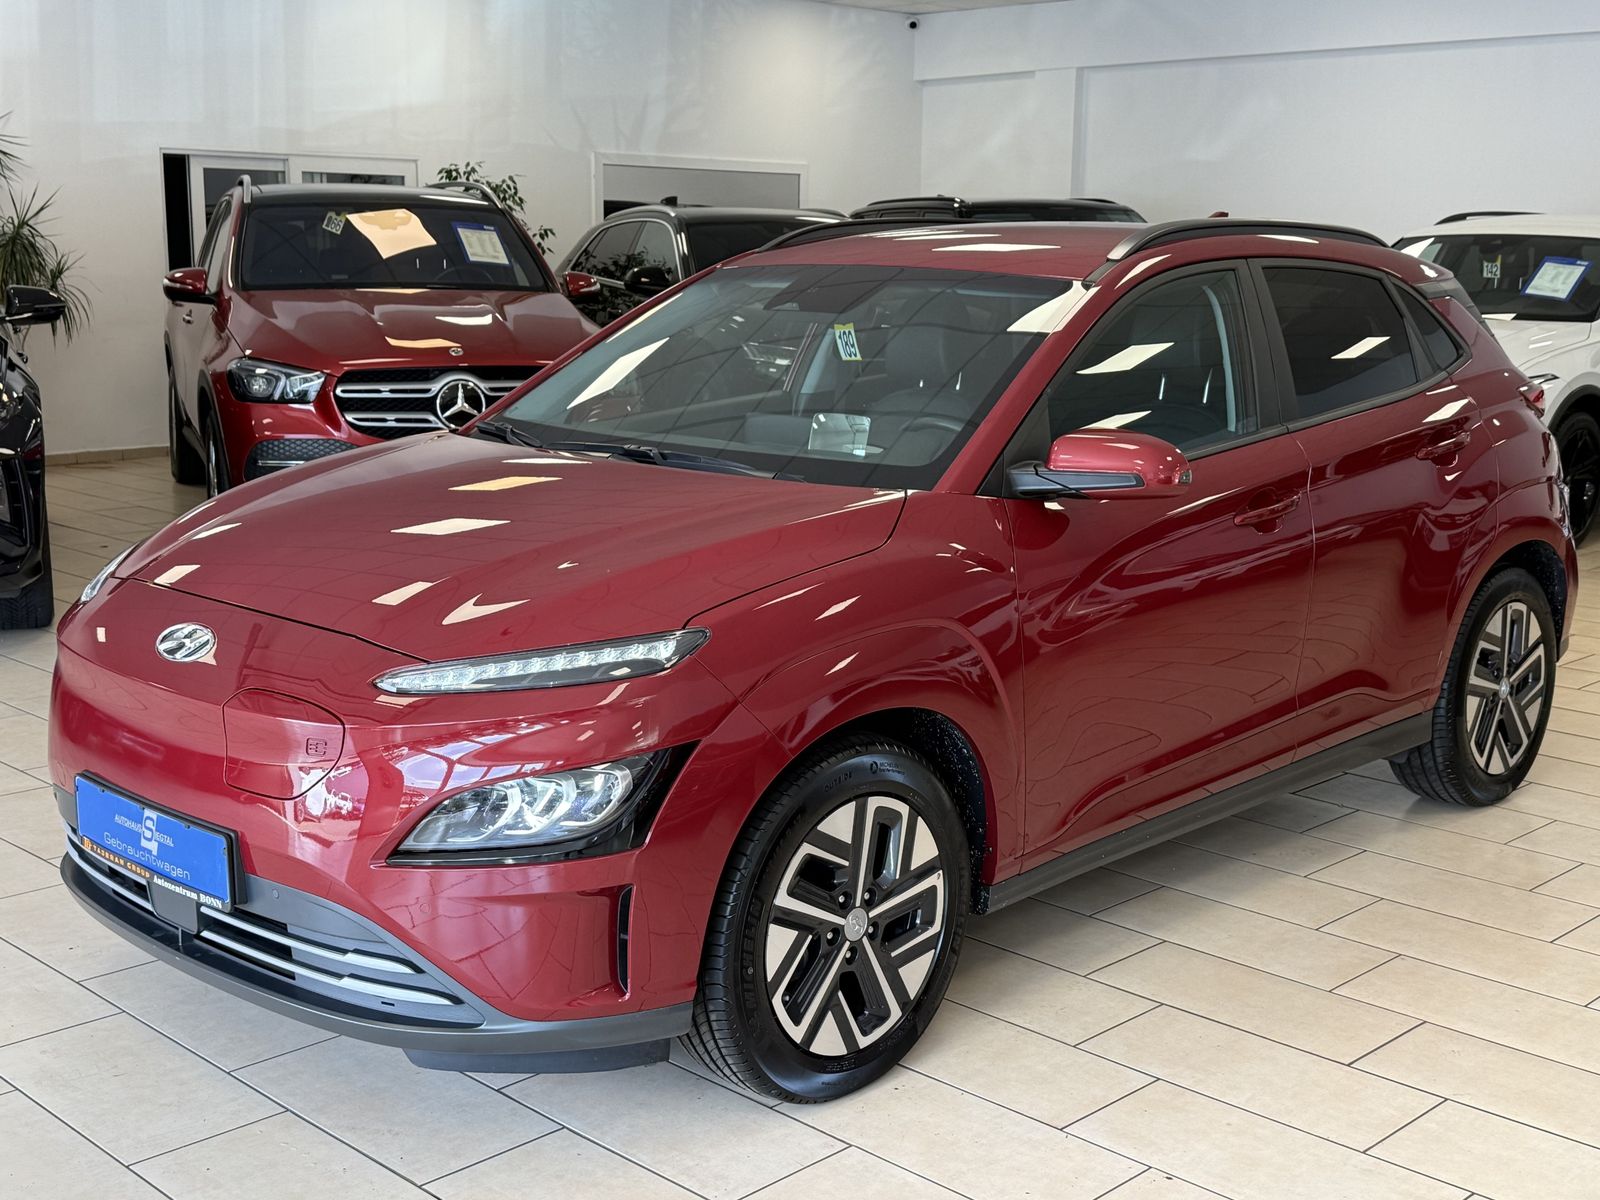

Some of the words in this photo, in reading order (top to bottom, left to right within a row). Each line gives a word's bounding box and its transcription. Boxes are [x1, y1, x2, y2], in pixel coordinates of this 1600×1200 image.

[1485, 262, 1499, 277] 142
[838, 330, 858, 359] 189
[103, 831, 190, 881] Gebrauchtwagen
[153, 874, 198, 900] Autozentrum
[199, 893, 223, 909] BONN
